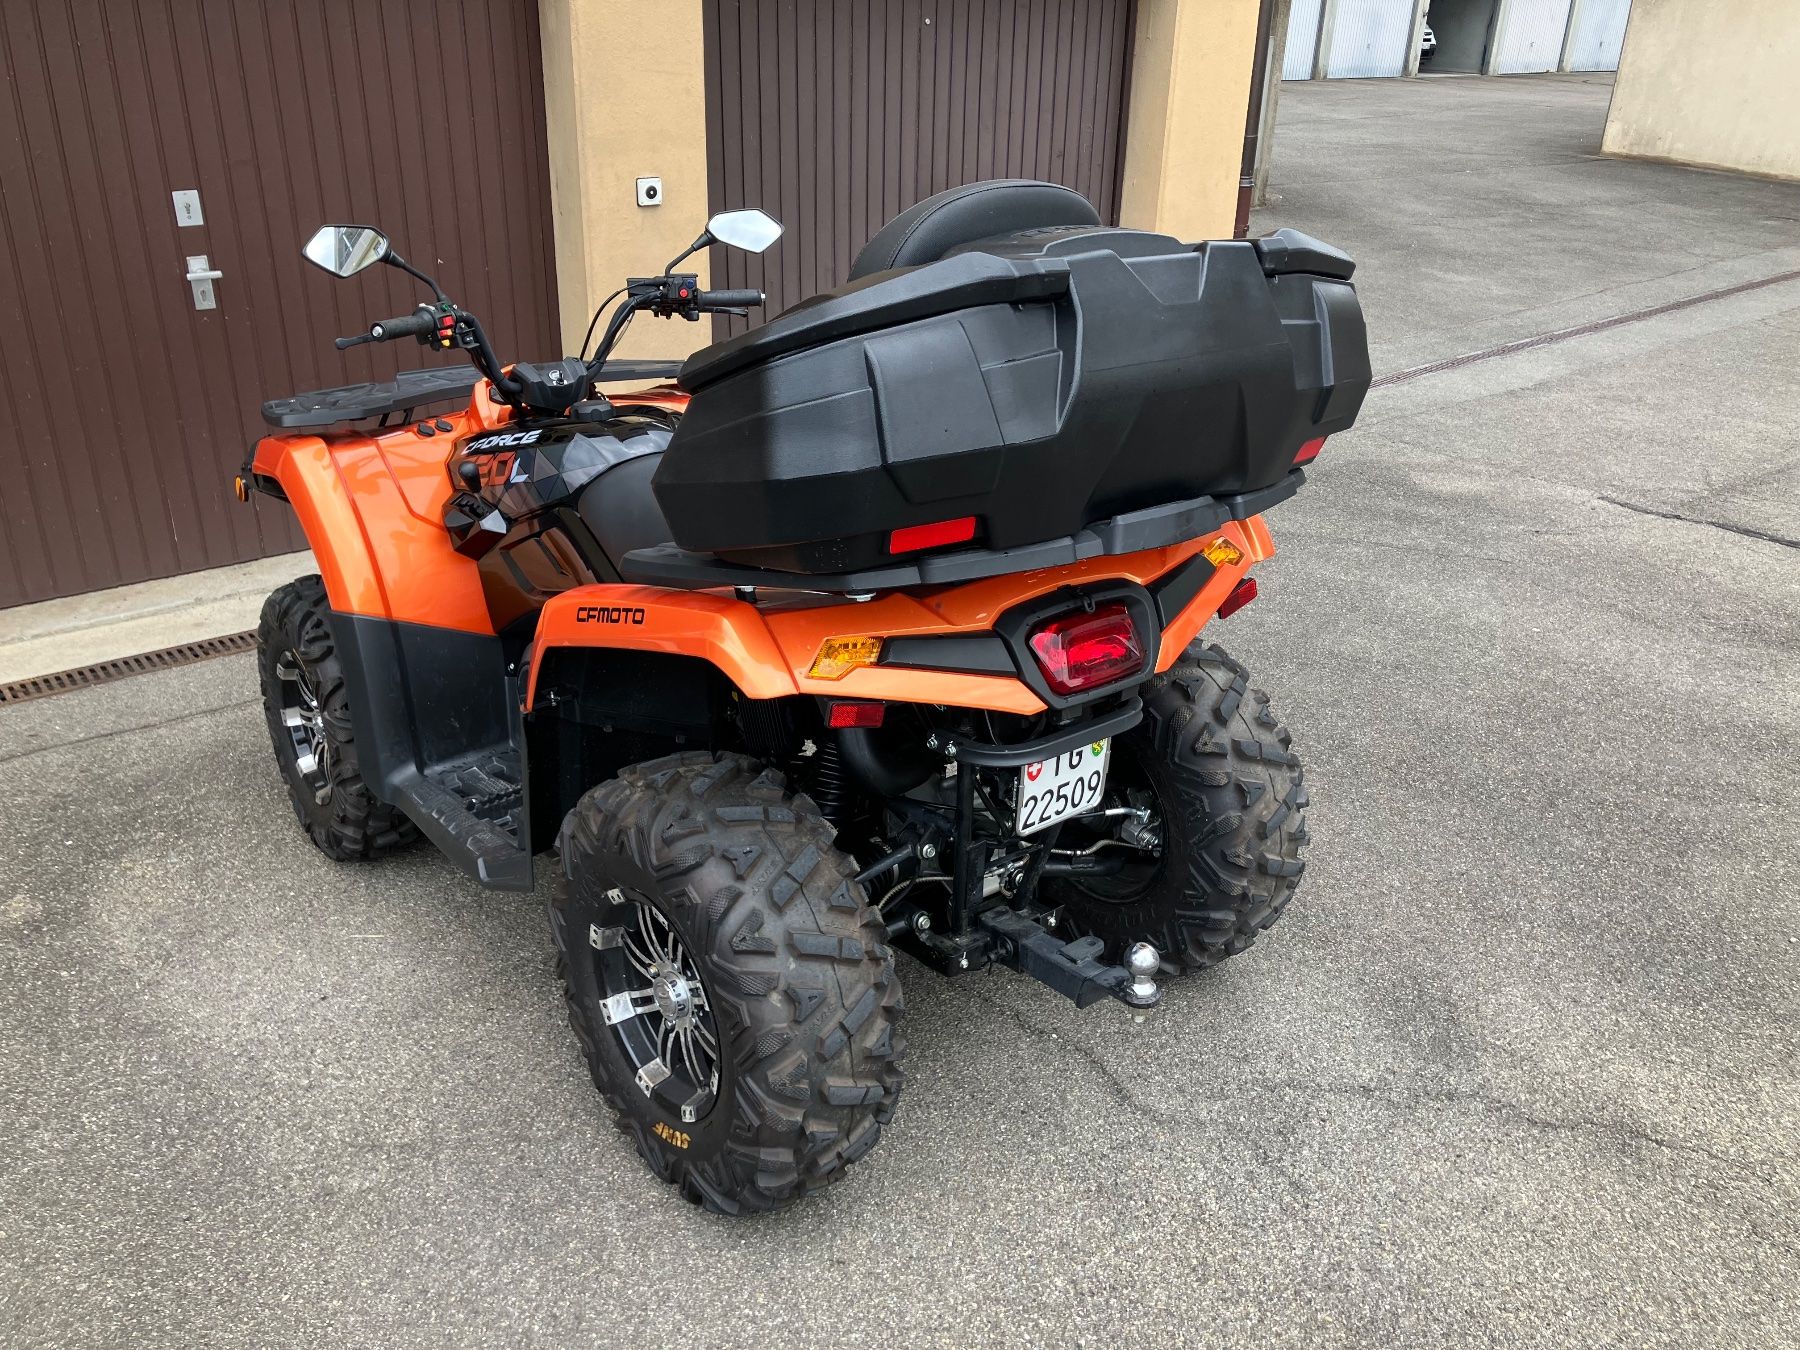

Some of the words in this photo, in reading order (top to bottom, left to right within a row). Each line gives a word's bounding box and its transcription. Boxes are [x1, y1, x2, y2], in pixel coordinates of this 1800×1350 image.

[461, 429, 543, 455] CFORCE
[576, 606, 646, 625] CFMOTO
[1021, 769, 1102, 831] 22509
